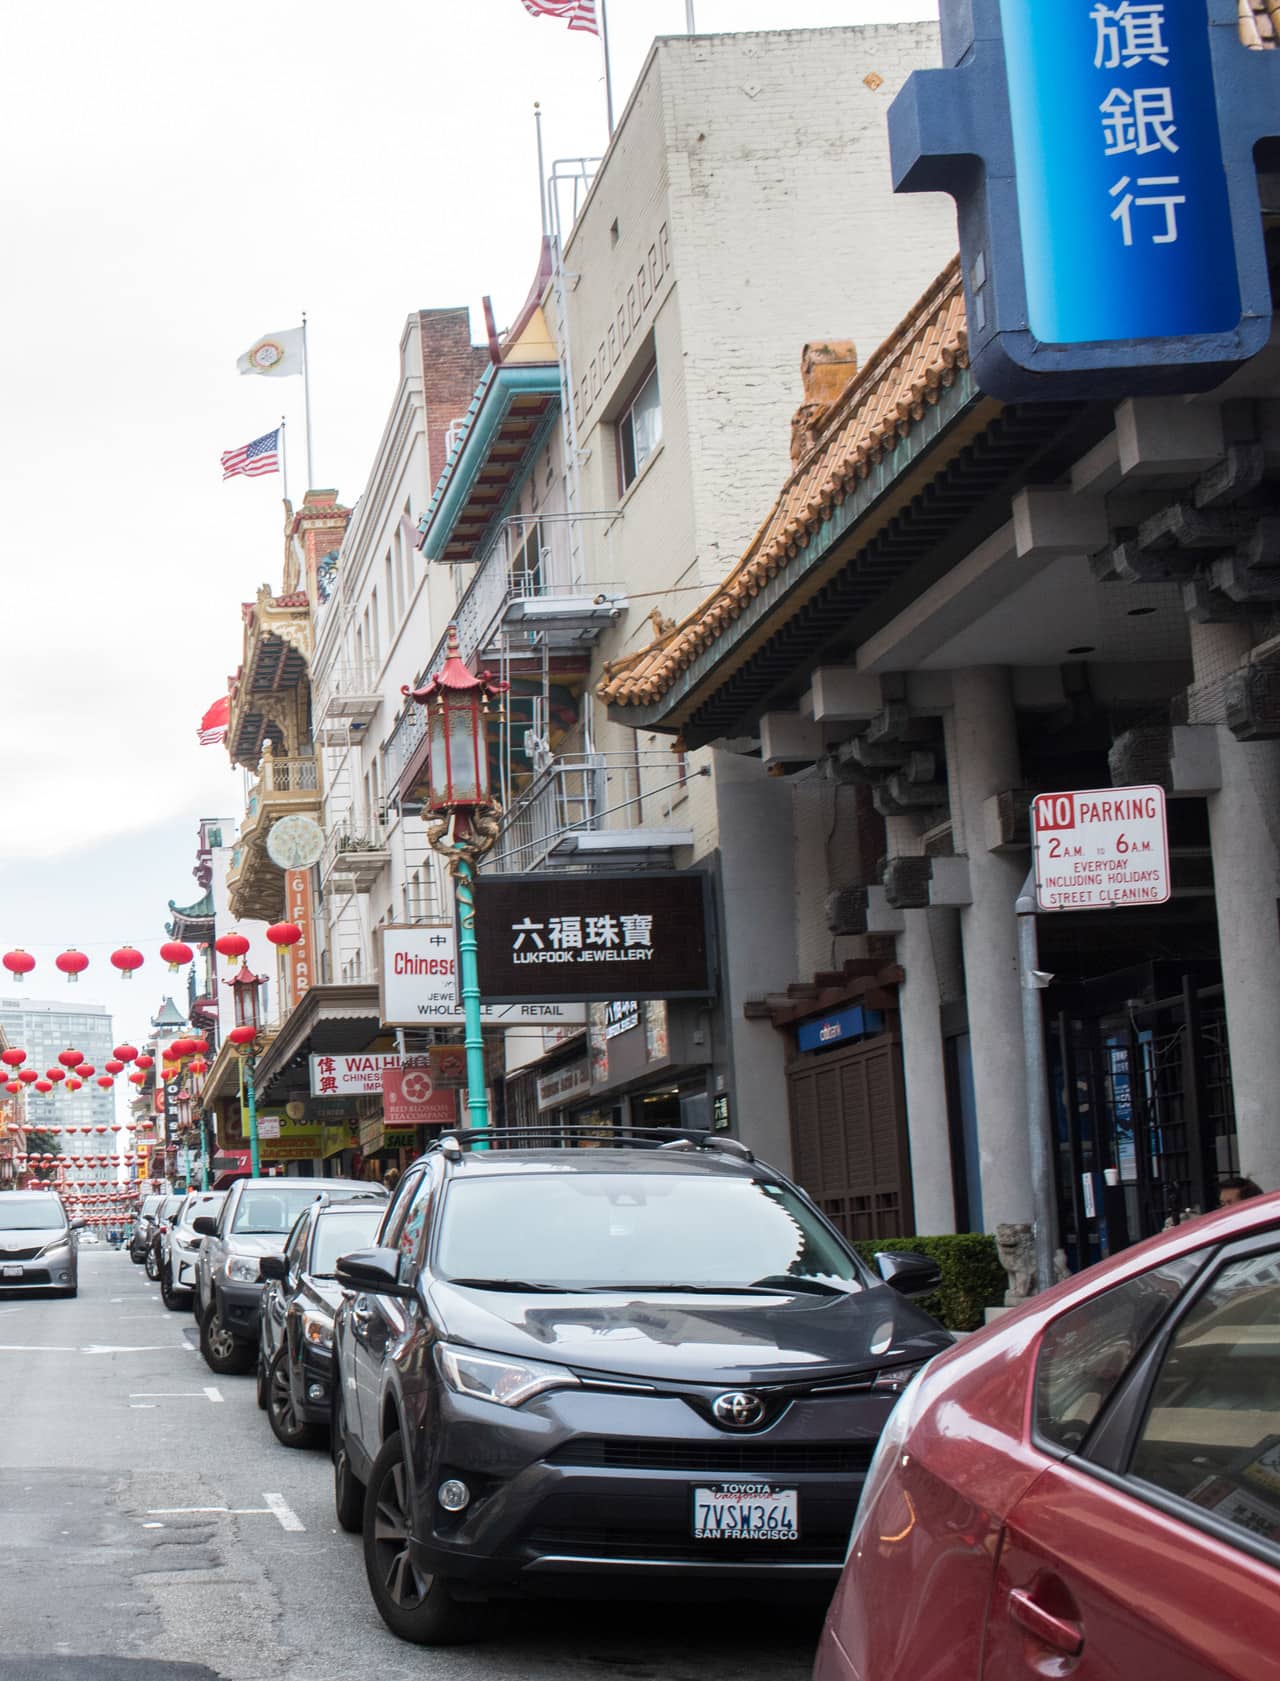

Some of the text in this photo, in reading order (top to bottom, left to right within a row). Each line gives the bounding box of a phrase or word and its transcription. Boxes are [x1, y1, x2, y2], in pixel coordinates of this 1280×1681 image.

[1088, 1, 1187, 247] 旗銀行
[1039, 797, 1156, 827] NO PARKING
[1074, 859, 1128, 873] EVERYDAY
[1045, 870, 1160, 888] INCLUDING HOLIDAYS
[1050, 886, 1158, 904] STREET CLEANING
[512, 913, 654, 951] 六福珠寶
[429, 934, 447, 948] 中
[513, 948, 655, 964] LUKFOOK JEWELLERY
[418, 1005, 493, 1017] WHOLELE
[521, 1005, 564, 1016] RETAIL
[346, 1057, 380, 1072] WAI
[342, 1073, 383, 1082] CHINES
[387, 1135, 415, 1147] SALE
[721, 1484, 770, 1493] TOYOTA
[699, 1504, 793, 1530] 7VSW364
[694, 1528, 798, 1541] SAN FRANCISCO
